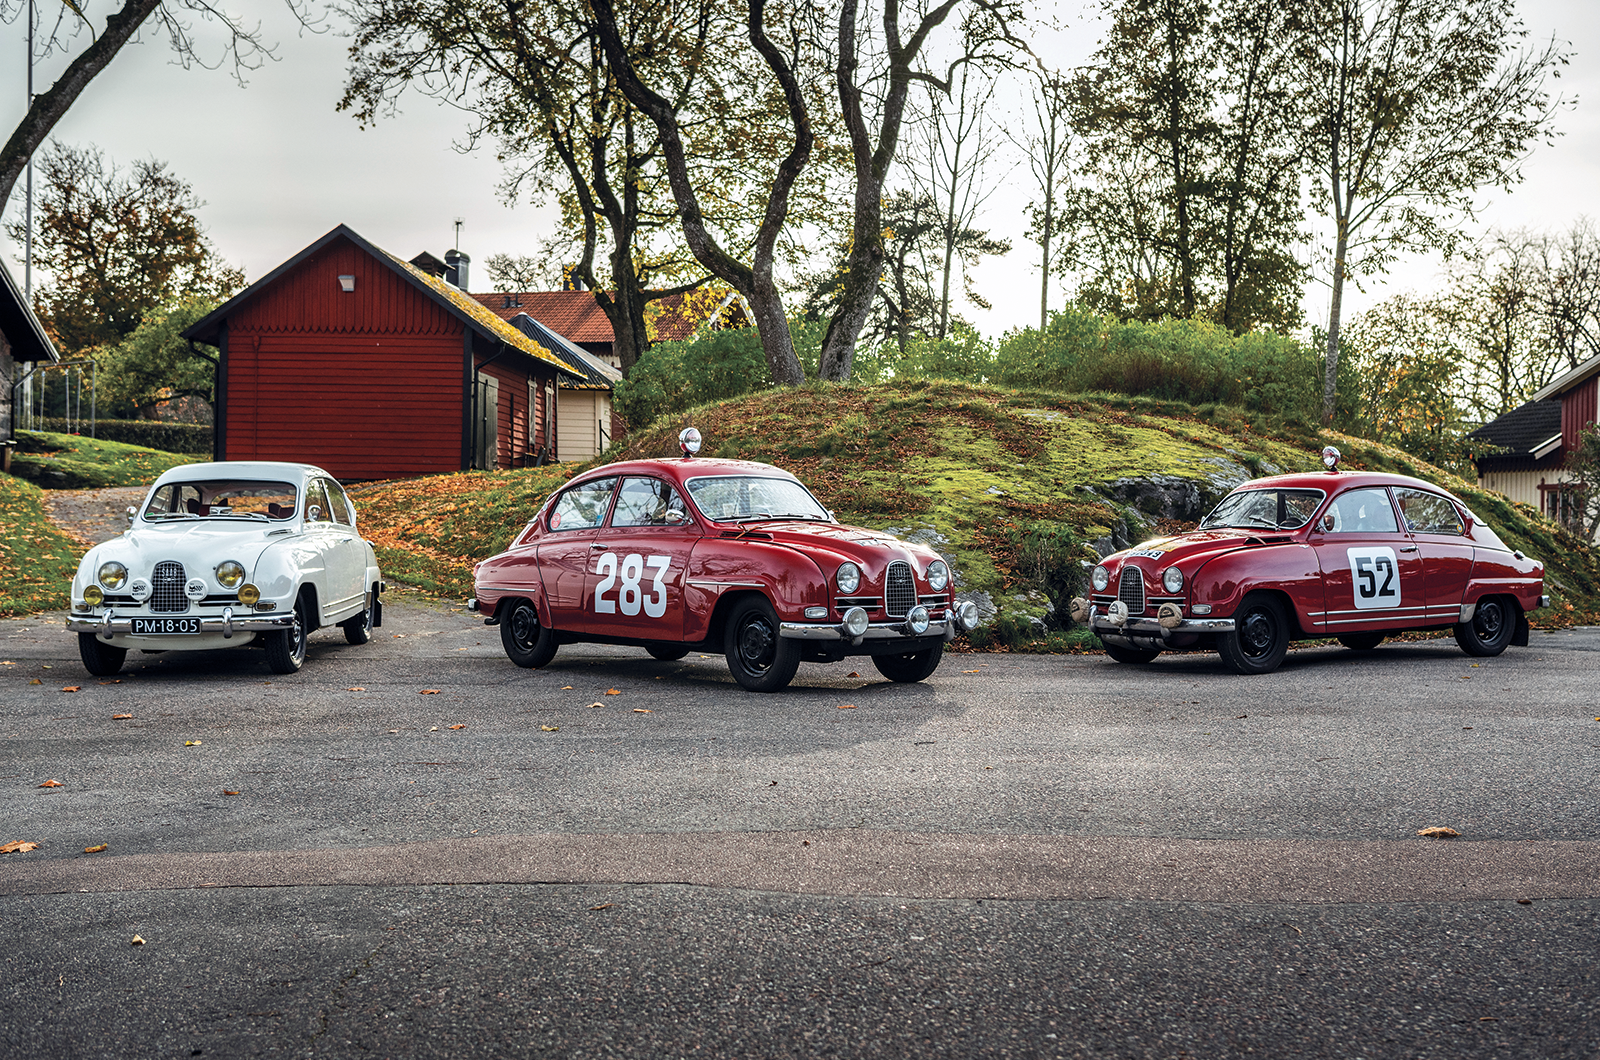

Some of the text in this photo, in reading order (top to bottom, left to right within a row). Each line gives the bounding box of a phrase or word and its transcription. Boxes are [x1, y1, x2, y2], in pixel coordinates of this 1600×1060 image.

[595, 552, 672, 618] 283
[1355, 556, 1396, 599] 52
[135, 619, 198, 633] PM-18-05
